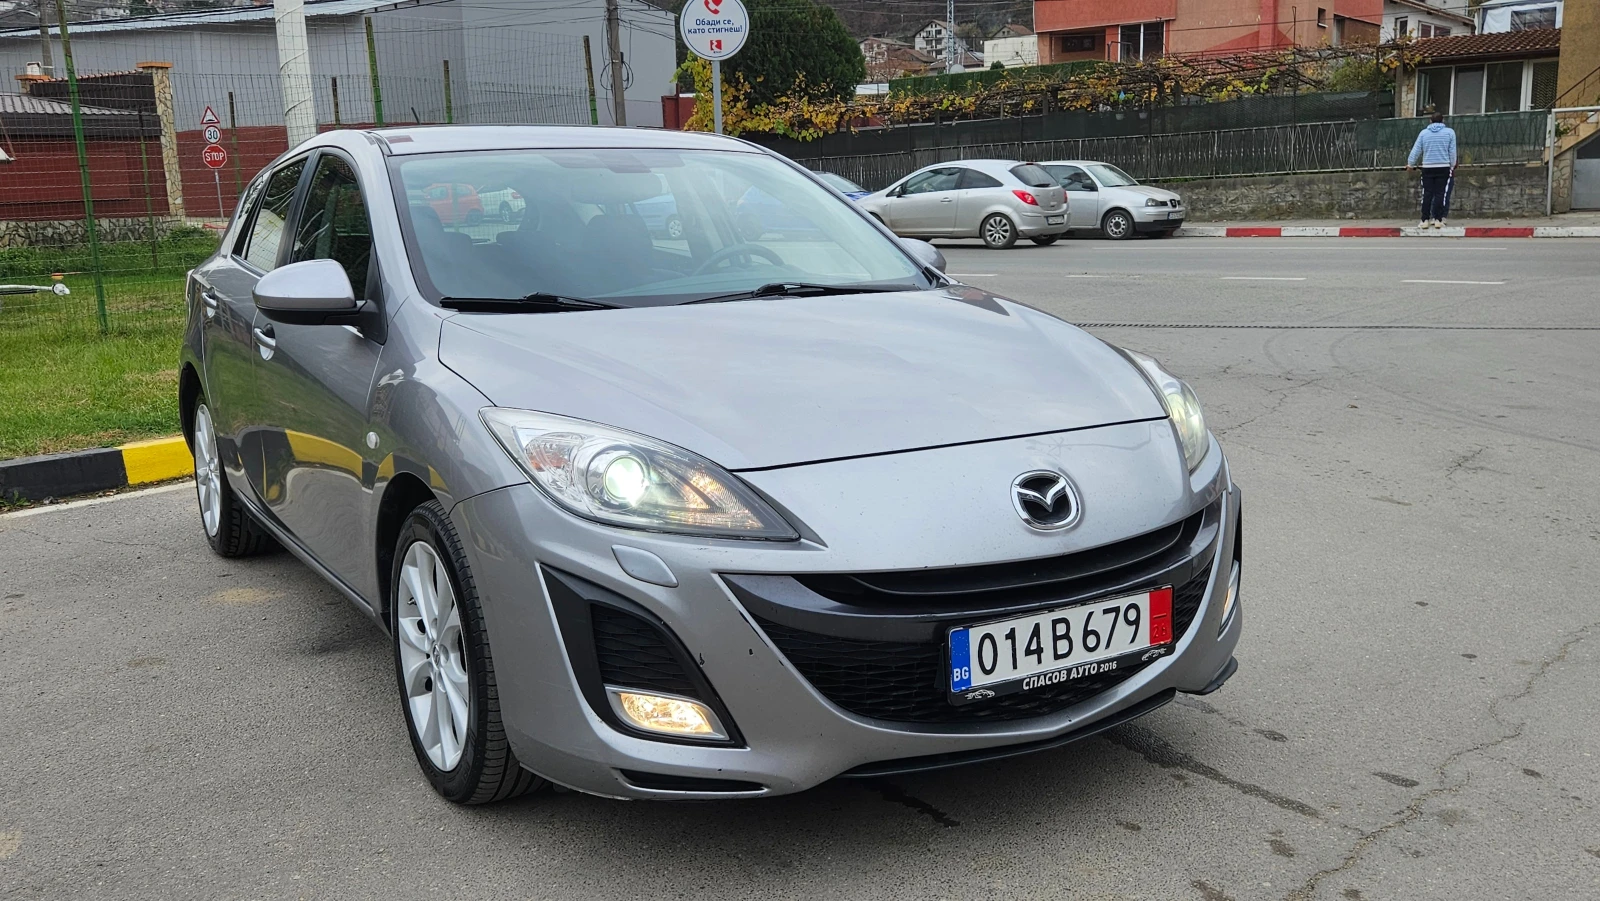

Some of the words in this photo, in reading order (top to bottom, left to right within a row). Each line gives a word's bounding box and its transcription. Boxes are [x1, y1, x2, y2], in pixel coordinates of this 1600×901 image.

[695, 18, 720, 26] Обади
[707, 25, 742, 33] стигнеш!
[207, 130, 218, 140] 30
[205, 152, 224, 161] STOP
[953, 666, 969, 682] BG
[1022, 670, 1067, 690] СПАСОВ
[1069, 663, 1098, 679] АУТО
[1099, 661, 1117, 672] 2016
